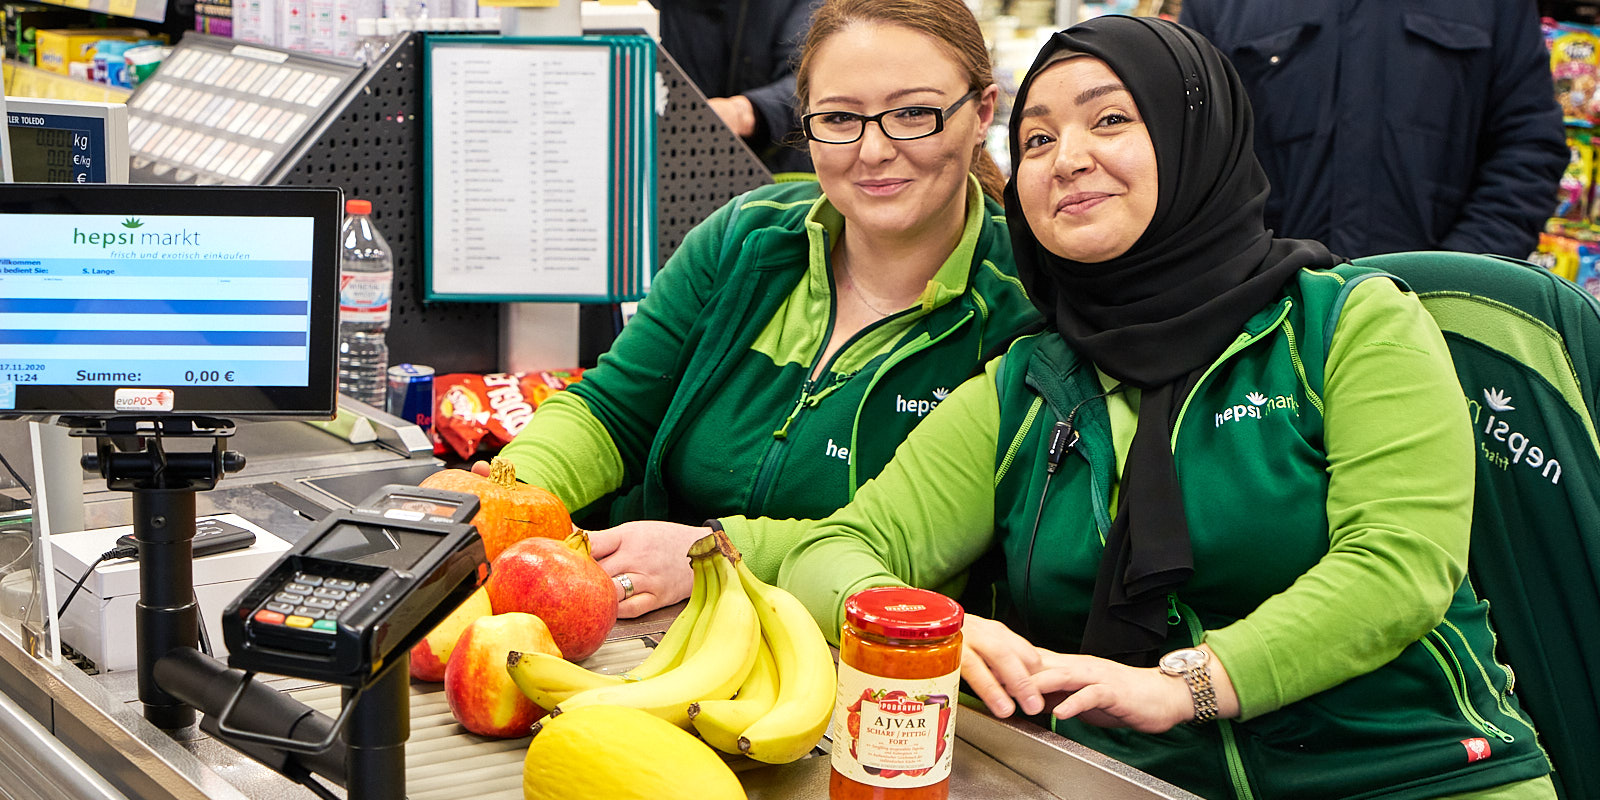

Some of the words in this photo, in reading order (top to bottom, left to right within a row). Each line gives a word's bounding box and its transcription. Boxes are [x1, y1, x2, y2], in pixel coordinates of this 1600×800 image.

[7, 115, 19, 124] LER
[21, 116, 45, 126] TOLEDO
[74, 133, 88, 150] kg
[73, 155, 91, 168] €/kg
[77, 173, 87, 183] €
[73, 227, 134, 249] hepsi
[141, 228, 201, 246] markt
[110, 251, 136, 260] frisch
[140, 251, 159, 260] und
[162, 251, 200, 260] exotisch
[204, 251, 250, 260] einkaufen
[4, 266, 32, 274] bedient
[34, 266, 49, 274] Sie:
[92, 268, 115, 276] Lange
[6, 373, 38, 382] 11:24
[76, 370, 142, 382] Summe:
[184, 370, 220, 384] 0,00
[224, 371, 235, 382] €
[116, 396, 153, 406] evoPOS
[896, 394, 938, 416] heps
[415, 413, 432, 426] Re
[874, 716, 926, 730] AJVAR
[866, 727, 896, 737] SCHARF
